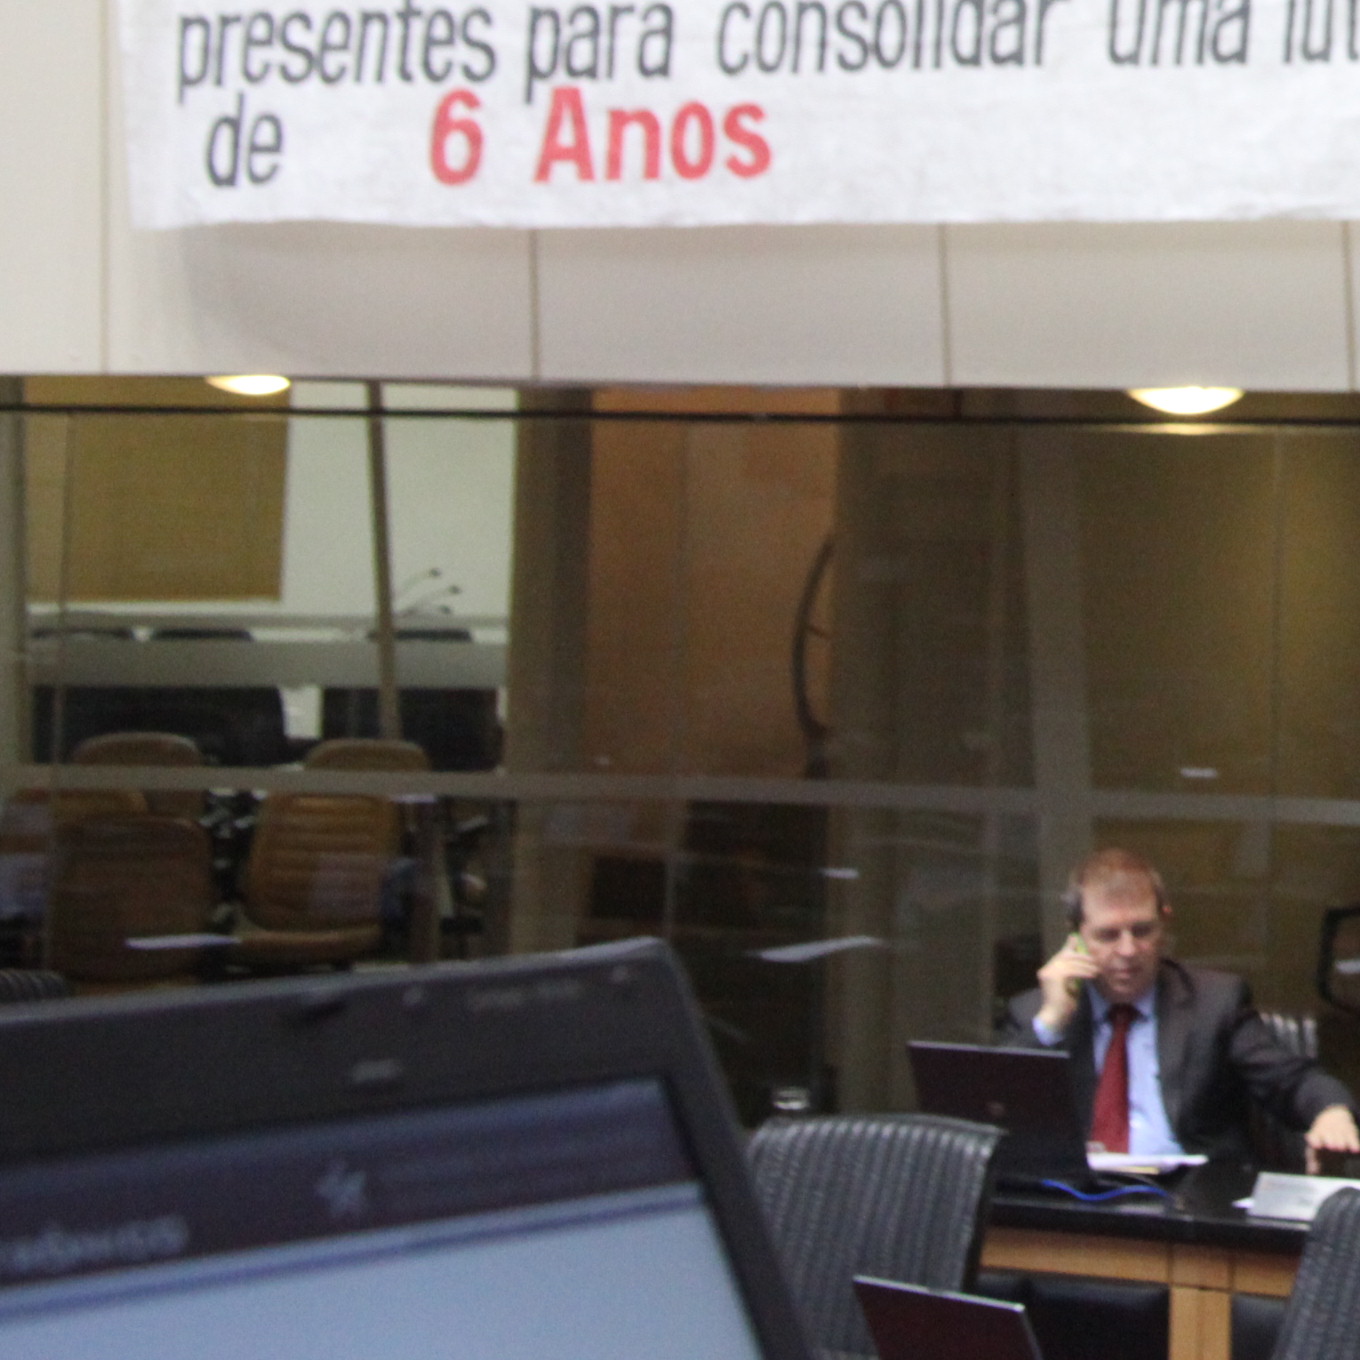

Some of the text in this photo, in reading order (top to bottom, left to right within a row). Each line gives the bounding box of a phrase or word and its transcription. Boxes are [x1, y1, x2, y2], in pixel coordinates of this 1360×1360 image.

[525, 2, 673, 104] para
[206, 86, 771, 186] de 6 Anos
